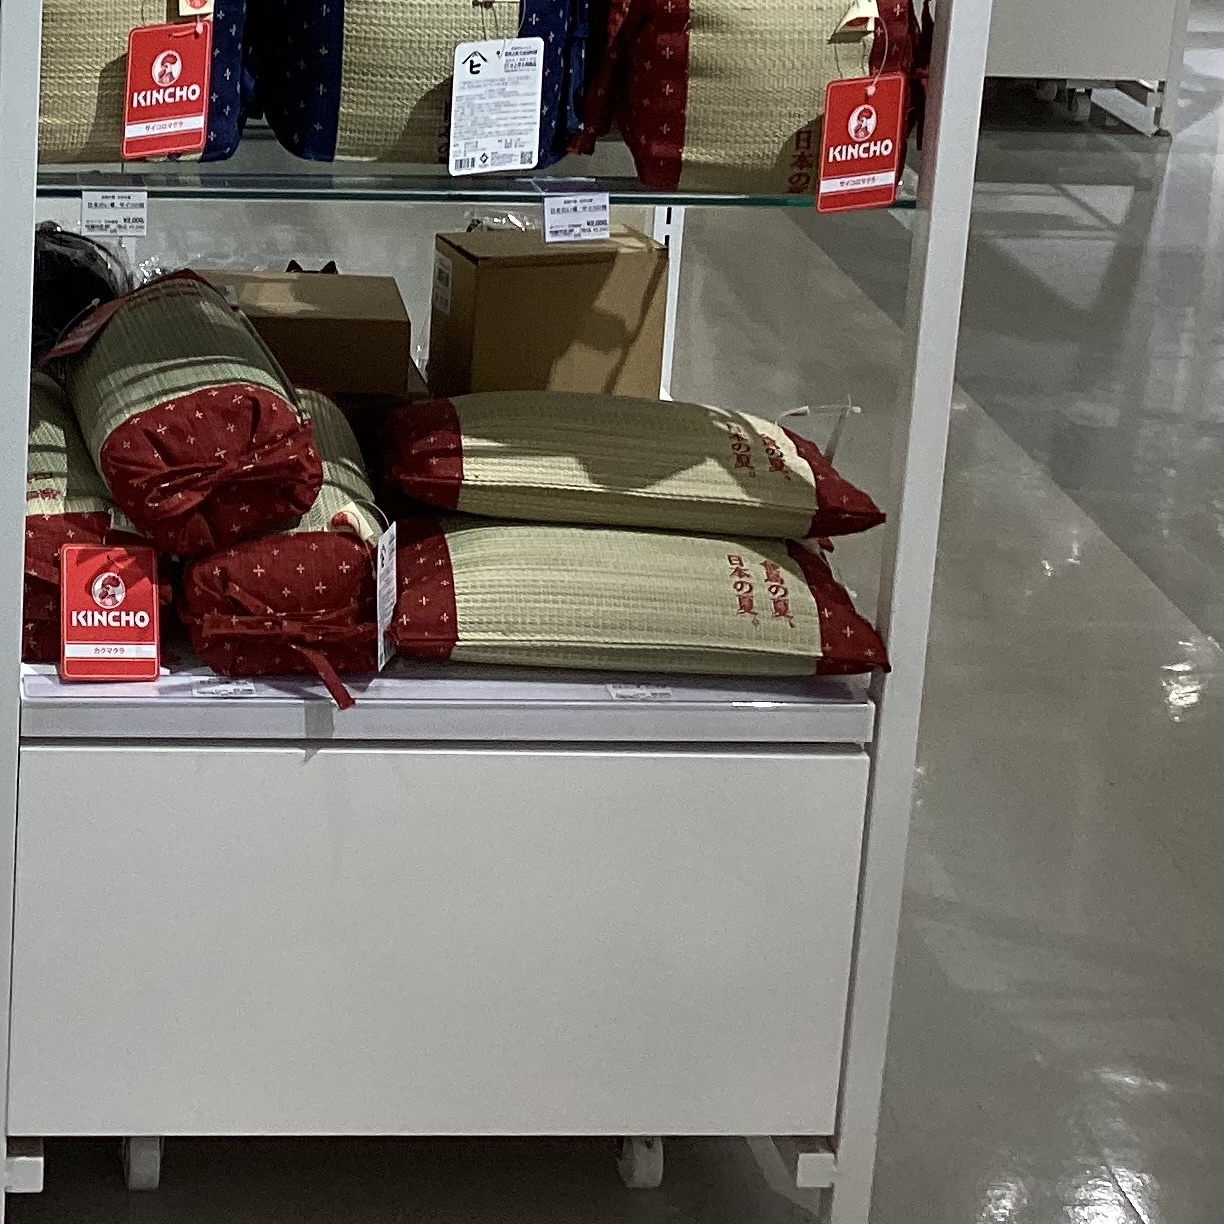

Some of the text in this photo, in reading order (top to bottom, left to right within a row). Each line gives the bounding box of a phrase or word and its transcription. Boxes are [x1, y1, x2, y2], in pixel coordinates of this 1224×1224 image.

[132, 83, 201, 108] KINCHO
[828, 138, 893, 163] KINCHO
[71, 609, 150, 629] KINCHO
